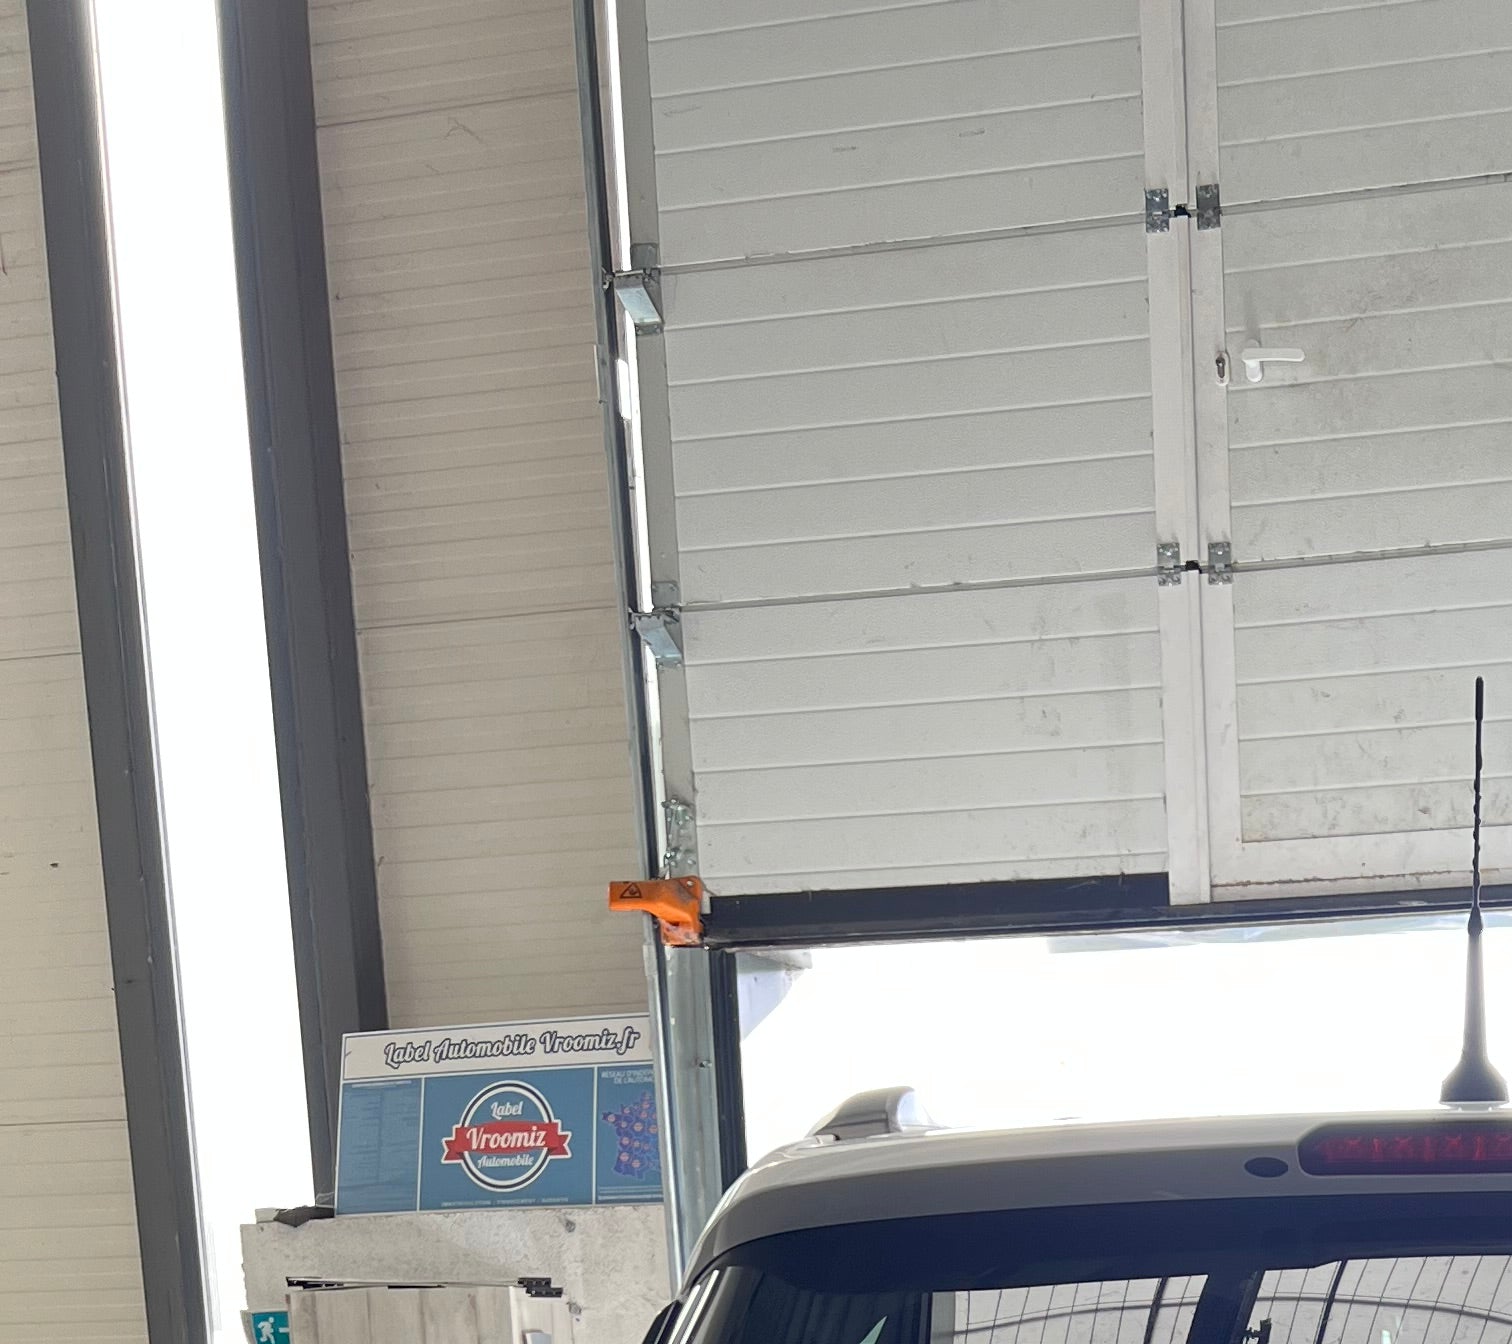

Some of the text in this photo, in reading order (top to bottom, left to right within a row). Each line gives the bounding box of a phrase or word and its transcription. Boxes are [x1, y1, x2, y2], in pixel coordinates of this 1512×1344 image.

[384, 1026, 641, 1069] Label Automobile Vroomiz.fr
[490, 1101, 524, 1120] Label
[466, 1126, 547, 1150] Vroomiz
[477, 1154, 535, 1169] Automobile
